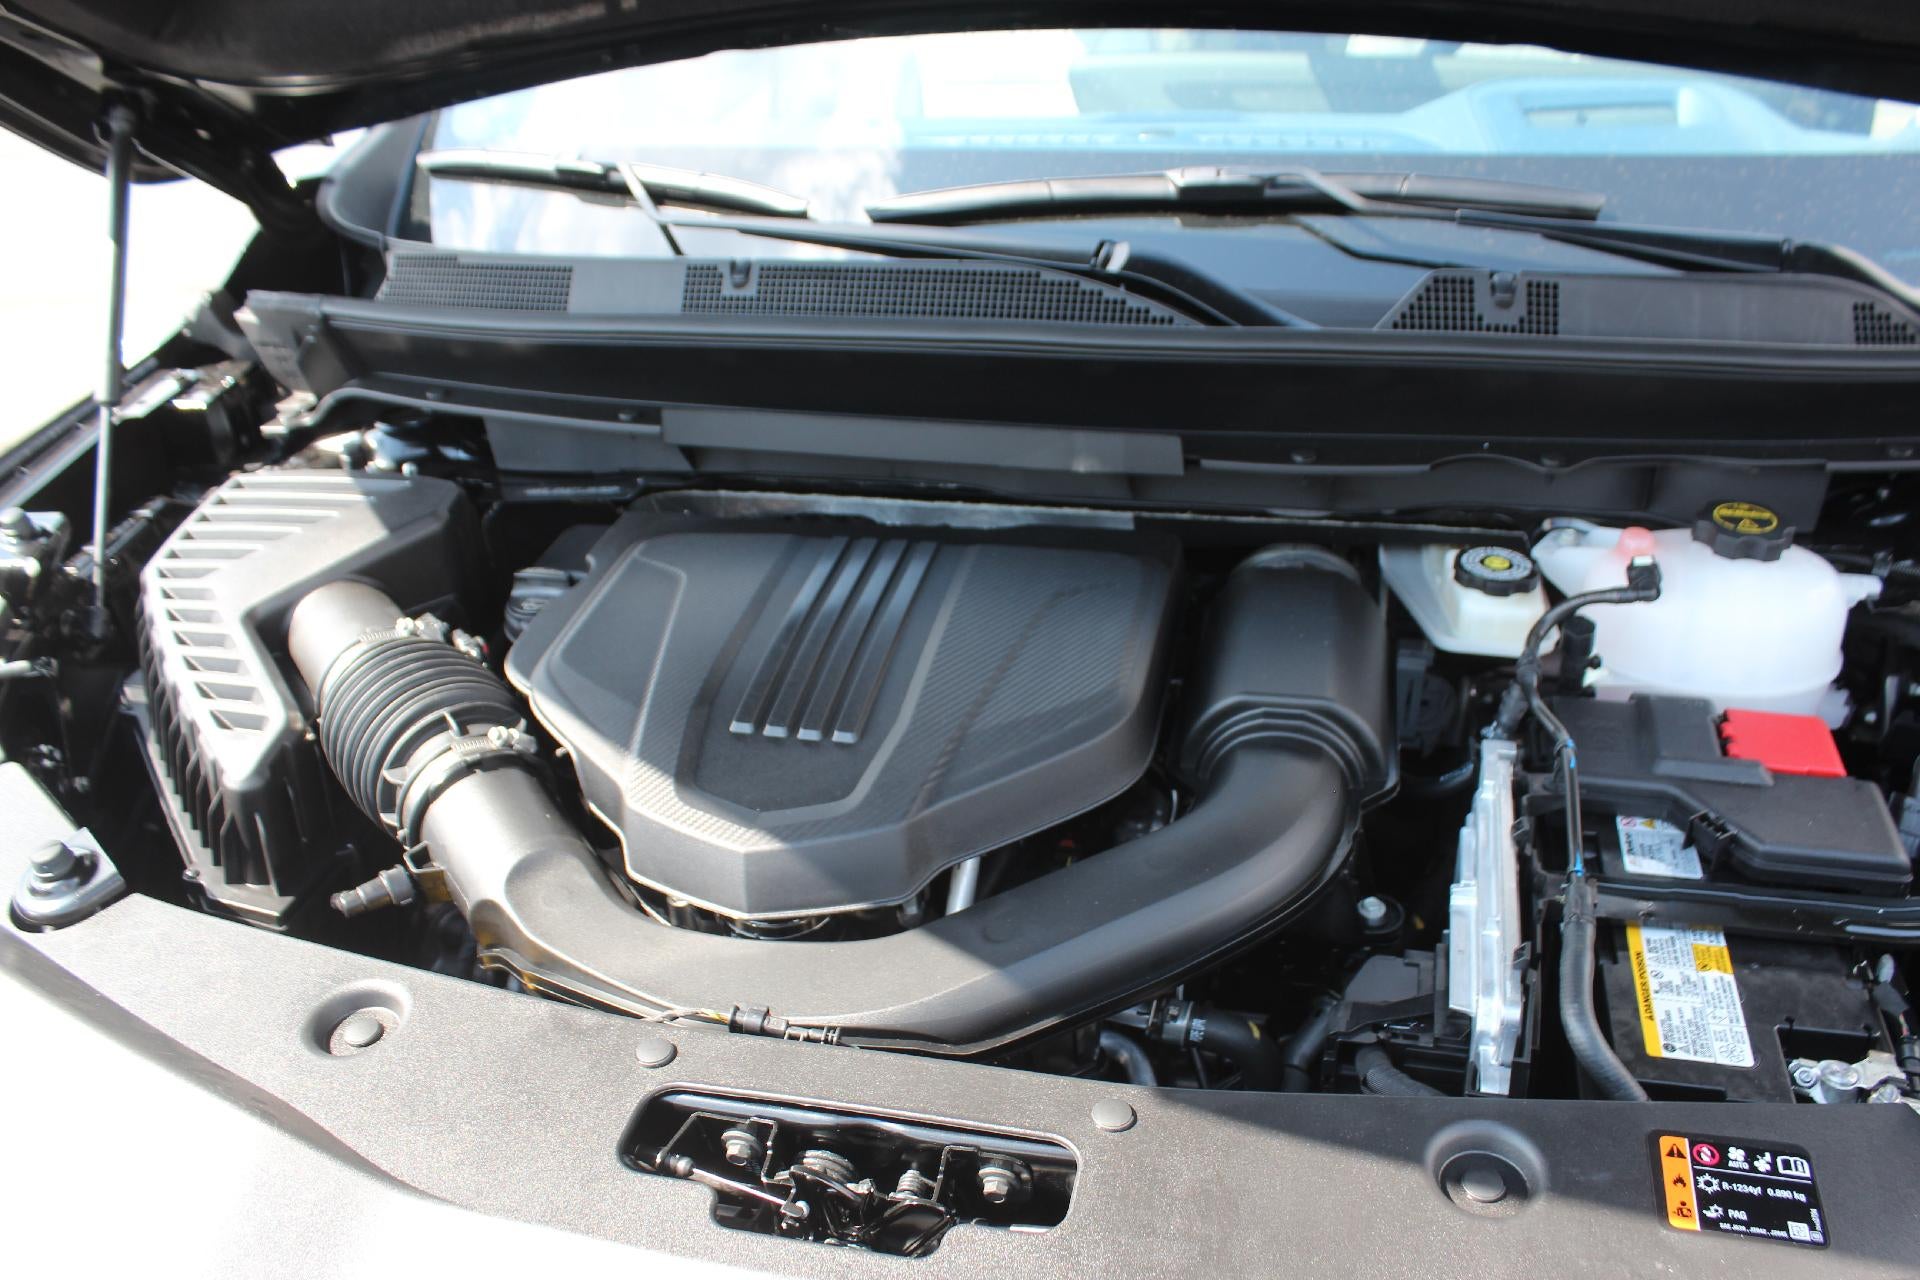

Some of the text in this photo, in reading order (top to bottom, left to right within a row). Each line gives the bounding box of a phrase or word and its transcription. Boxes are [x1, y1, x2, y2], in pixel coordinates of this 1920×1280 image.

[1728, 1160, 1750, 1170] AUTO
[1722, 1181, 1762, 1196] R-1234yf
[1793, 1190, 1807, 1203] kg
